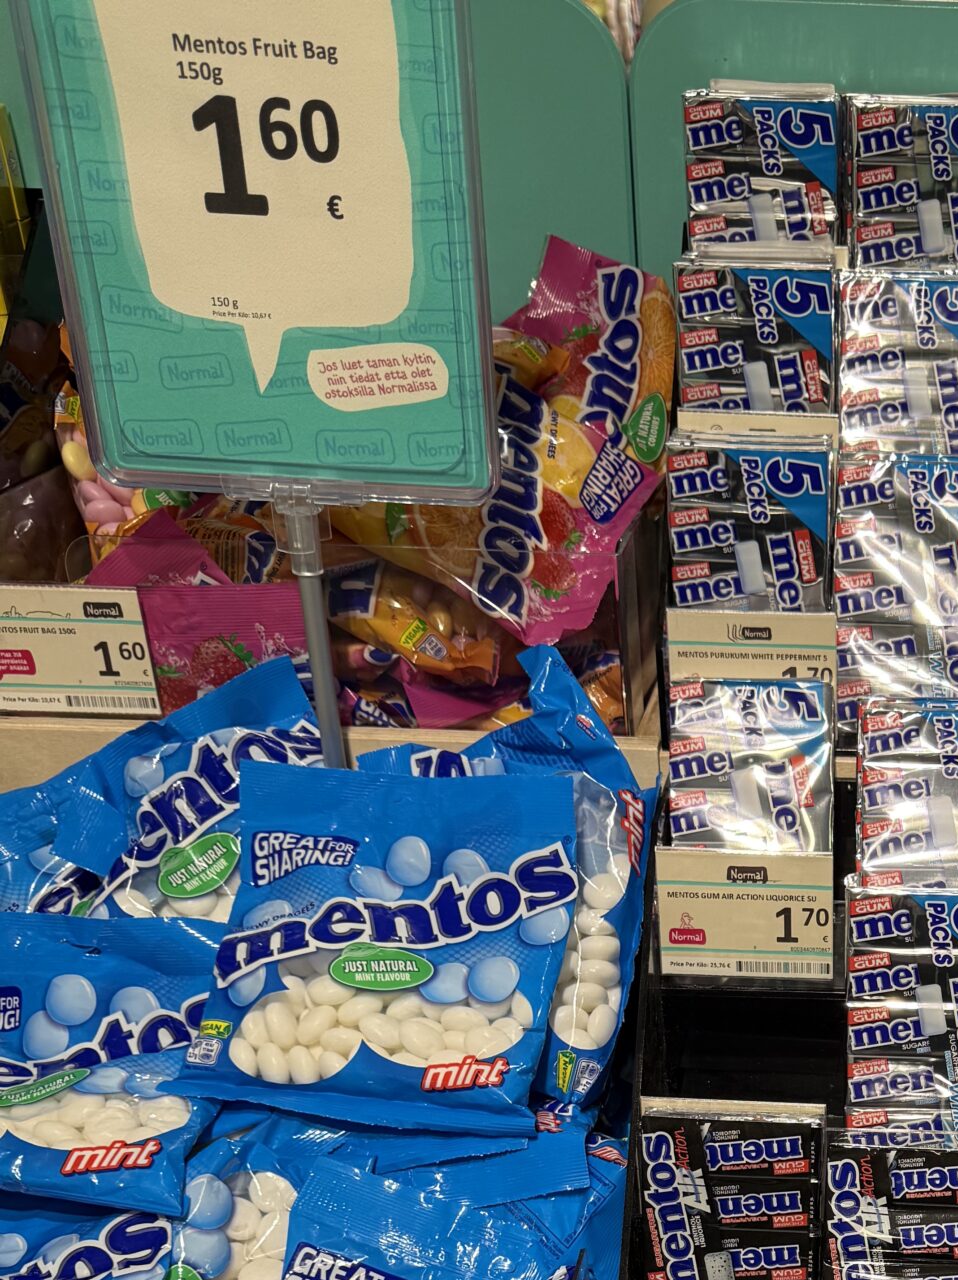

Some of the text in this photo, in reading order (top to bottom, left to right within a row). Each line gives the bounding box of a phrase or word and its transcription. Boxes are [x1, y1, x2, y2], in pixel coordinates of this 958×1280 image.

[172, 33, 338, 65] Mentos Fruit Bag
[176, 61, 224, 85] 150g
[777, 106, 835, 148] 5
[753, 107, 783, 176] PACKS
[327, 195, 344, 220] €
[211, 297, 230, 307] 150
[317, 361, 338, 374] Jos
[341, 359, 364, 371] luet
[366, 357, 400, 369] taman
[327, 367, 432, 386] niin tiedat etta olet
[325, 381, 438, 399] ostoksilla Normalissa
[132, 425, 194, 447] Normal
[86, 605, 119, 617] Normal
[744, 629, 770, 639] Normal
[677, 651, 822, 662] MENTOS PURUKUMI WHITE PEPPERMINT
[254, 832, 356, 857] GREAT FOR
[254, 848, 355, 886] SHARING!
[730, 868, 765, 881] Normal
[667, 891, 700, 899] MENTOS
[701, 892, 720, 900] GUM
[766, 894, 806, 902] LIQUORICE
[214, 841, 578, 988] mentos
[671, 931, 703, 942] Normal
[342, 959, 420, 974] JUST NATURAL
[355, 972, 412, 983] MINT FLAVOUR
[422, 1056, 509, 1092] mint
[62, 1141, 162, 1175] mint
